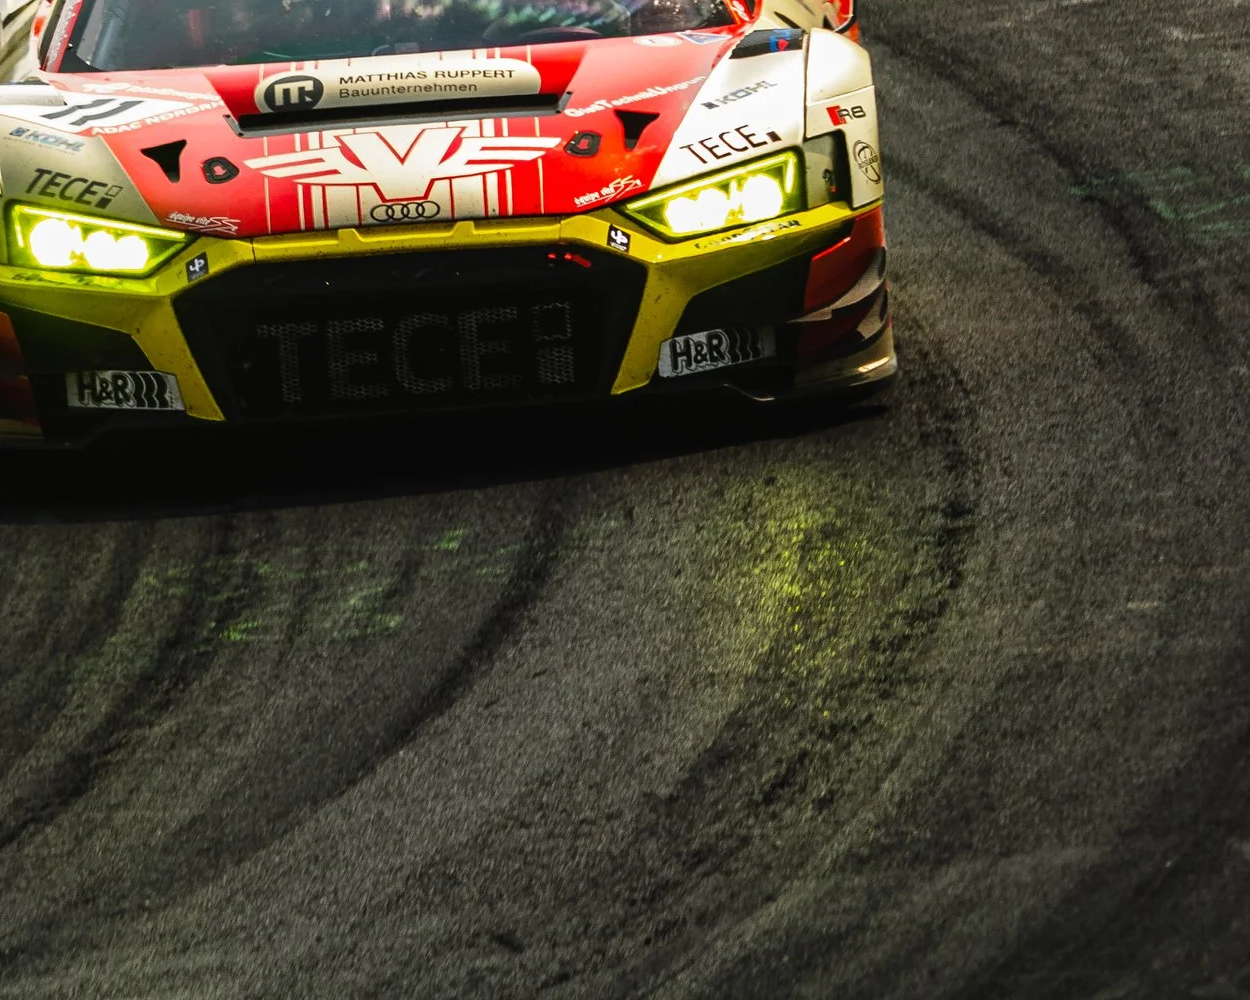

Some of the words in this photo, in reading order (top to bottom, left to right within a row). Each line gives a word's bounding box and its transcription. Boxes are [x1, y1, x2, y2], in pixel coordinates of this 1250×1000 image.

[339, 71, 427, 85] MATTHIAS
[435, 69, 516, 79] RUPPERT
[339, 83, 478, 99] Bauunternehmen
[837, 105, 866, 120] R8
[91, 122, 142, 136] ADAC
